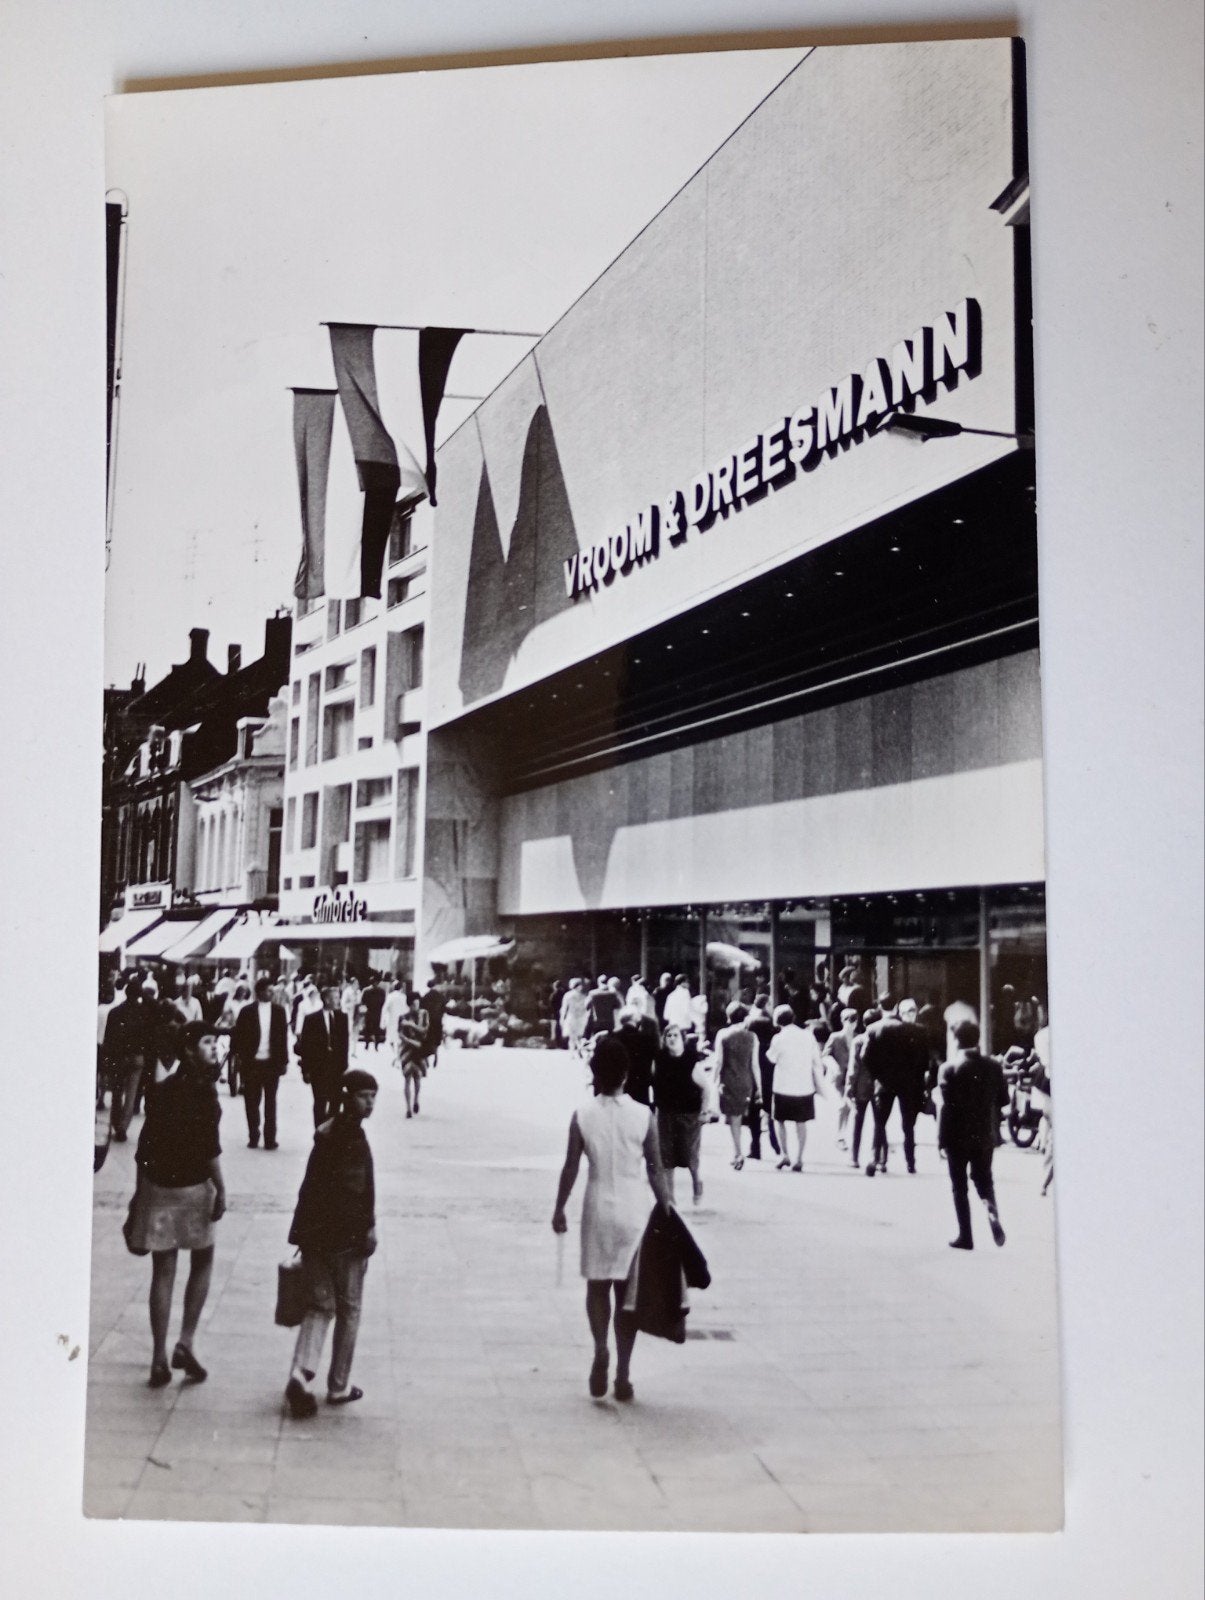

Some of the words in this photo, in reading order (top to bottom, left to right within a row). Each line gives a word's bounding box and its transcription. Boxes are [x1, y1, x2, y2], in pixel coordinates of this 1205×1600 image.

[562, 505, 660, 601] VROOM
[664, 490, 687, 547] &
[688, 298, 981, 531] DREESMANN
